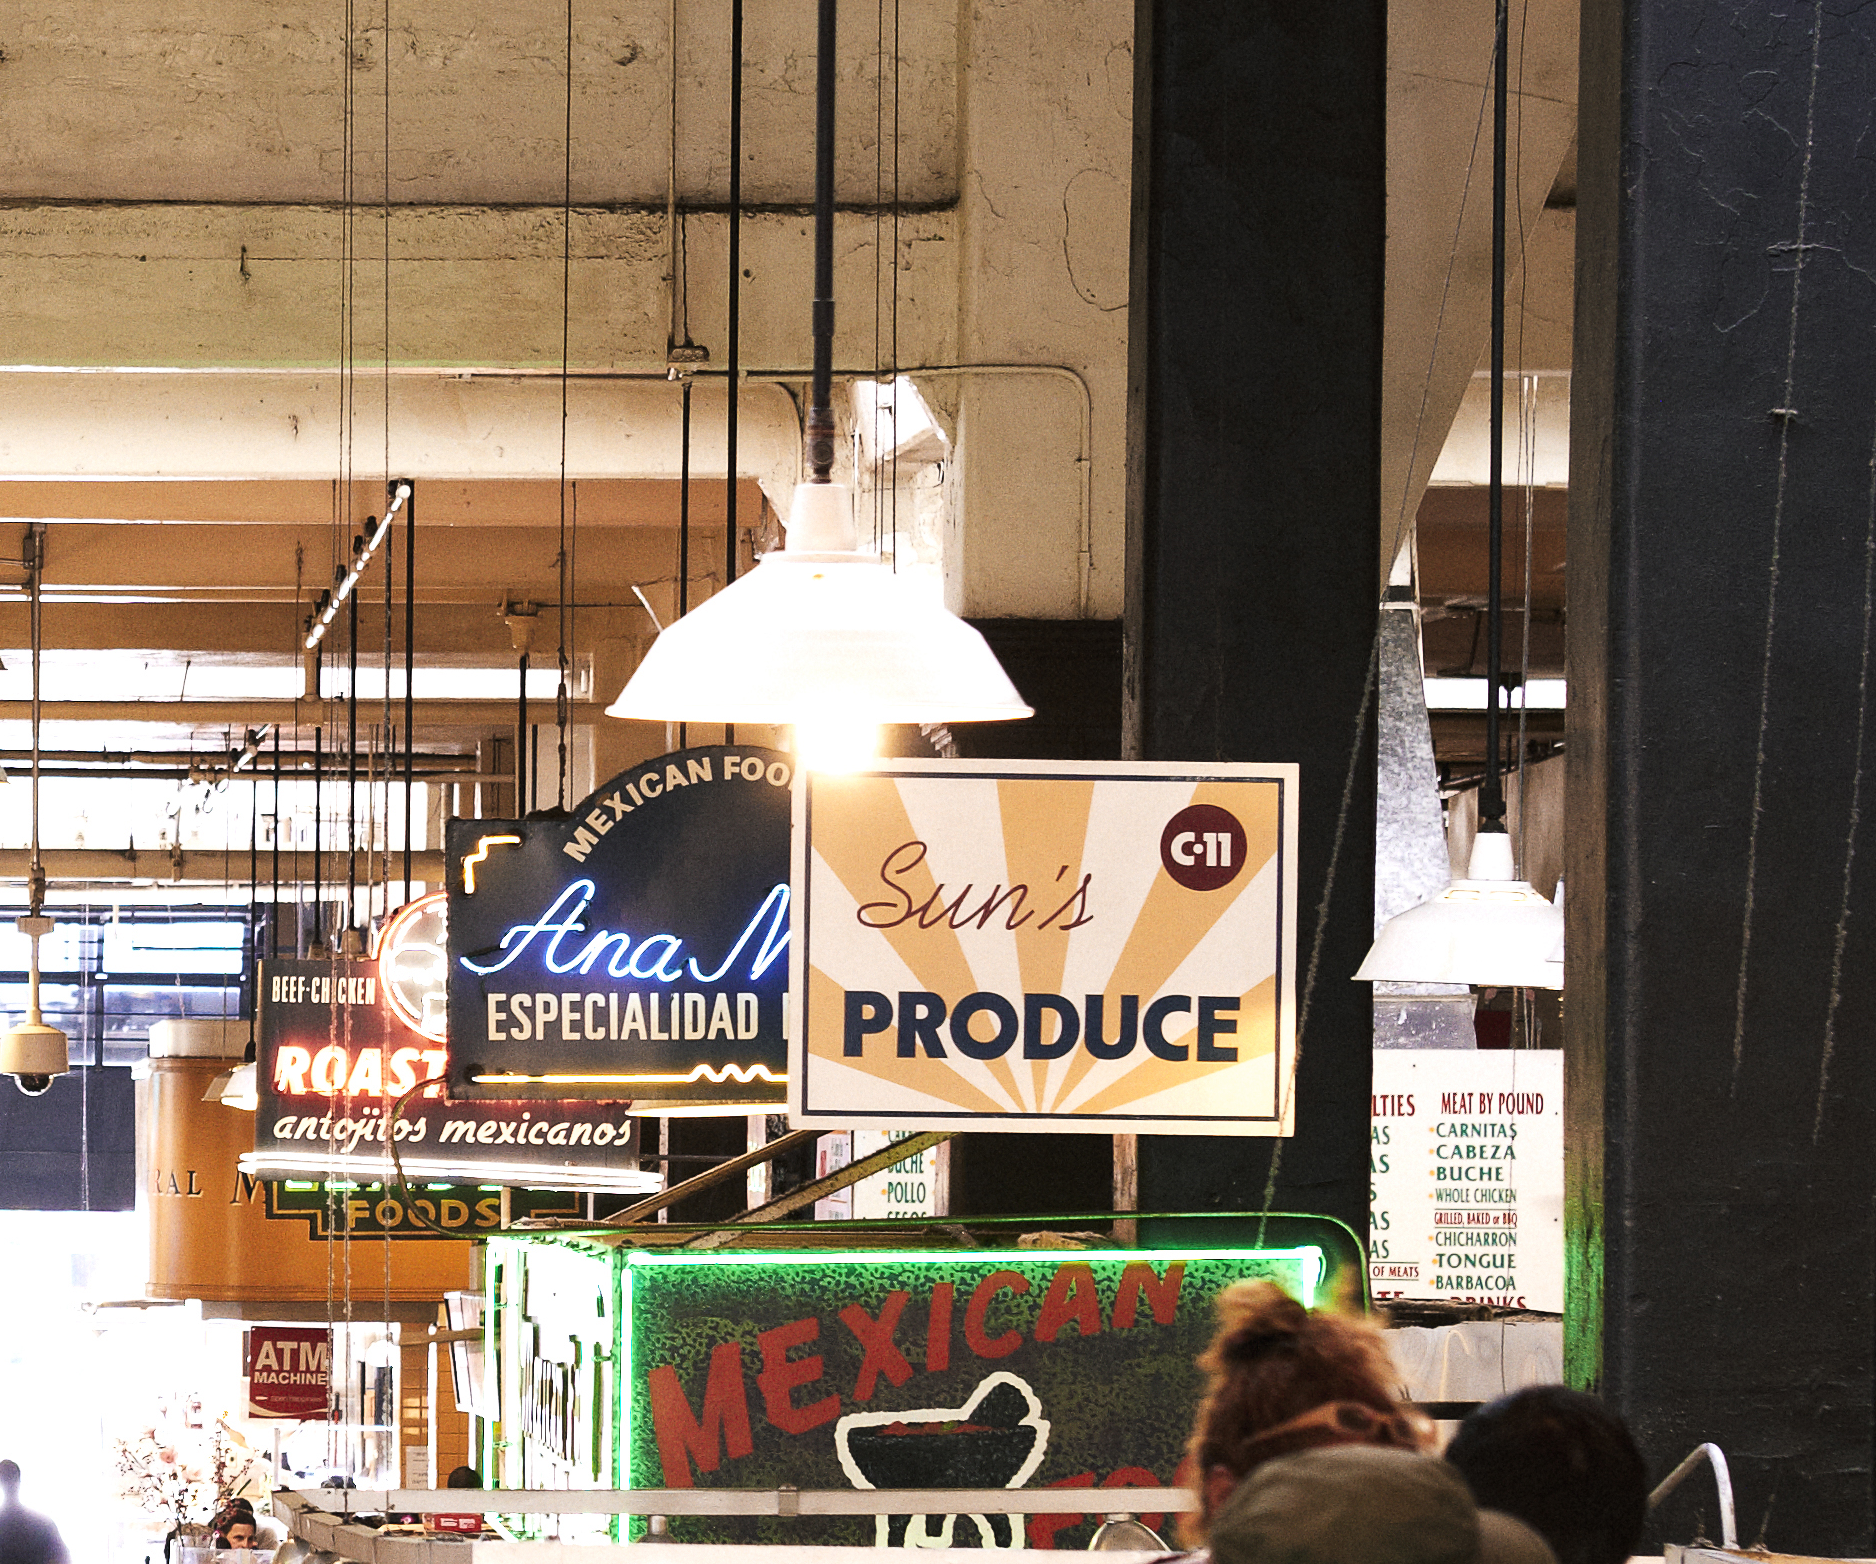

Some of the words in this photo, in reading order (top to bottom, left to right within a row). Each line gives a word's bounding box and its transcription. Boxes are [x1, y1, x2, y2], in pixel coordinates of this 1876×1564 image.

[563, 756, 713, 863] MEXICAN
[724, 755, 792, 791] FOO
[857, 840, 1095, 932] Sun's
[458, 878, 687, 981] Ana
[486, 993, 759, 1041] ESPECIALIDAD
[842, 990, 1242, 1064] PRODUCE
[274, 1044, 449, 1100] ROAST
[1441, 1092, 1474, 1115] MEAT
[1479, 1092, 1494, 1115] BY
[1499, 1092, 1544, 1115] POUND
[273, 1107, 427, 1154] antojitos
[438, 1110, 632, 1148] mexicanos
[1436, 1123, 1517, 1139] CARNITAS
[1436, 1145, 1516, 1160] CABEZA
[1436, 1166, 1504, 1182] BUCHE
[887, 1181, 926, 1204] POLLO
[1435, 1188, 1470, 1203] WHOLE
[1474, 1188, 1517, 1204] CHICKEN
[347, 1198, 502, 1229] FOODS
[1467, 1212, 1491, 1225] BAKED
[1503, 1212, 1518, 1228] BBQ
[1435, 1231, 1517, 1247] CHICHARRON
[1373, 1266, 1385, 1278] OF
[1389, 1266, 1419, 1278] MEATS
[1436, 1254, 1517, 1269] TONGUE
[1436, 1275, 1517, 1291] BARBACOA
[254, 1340, 328, 1372] ATM
[253, 1371, 328, 1386] MACHINE
[648, 1262, 1186, 1490] MEXICAN
